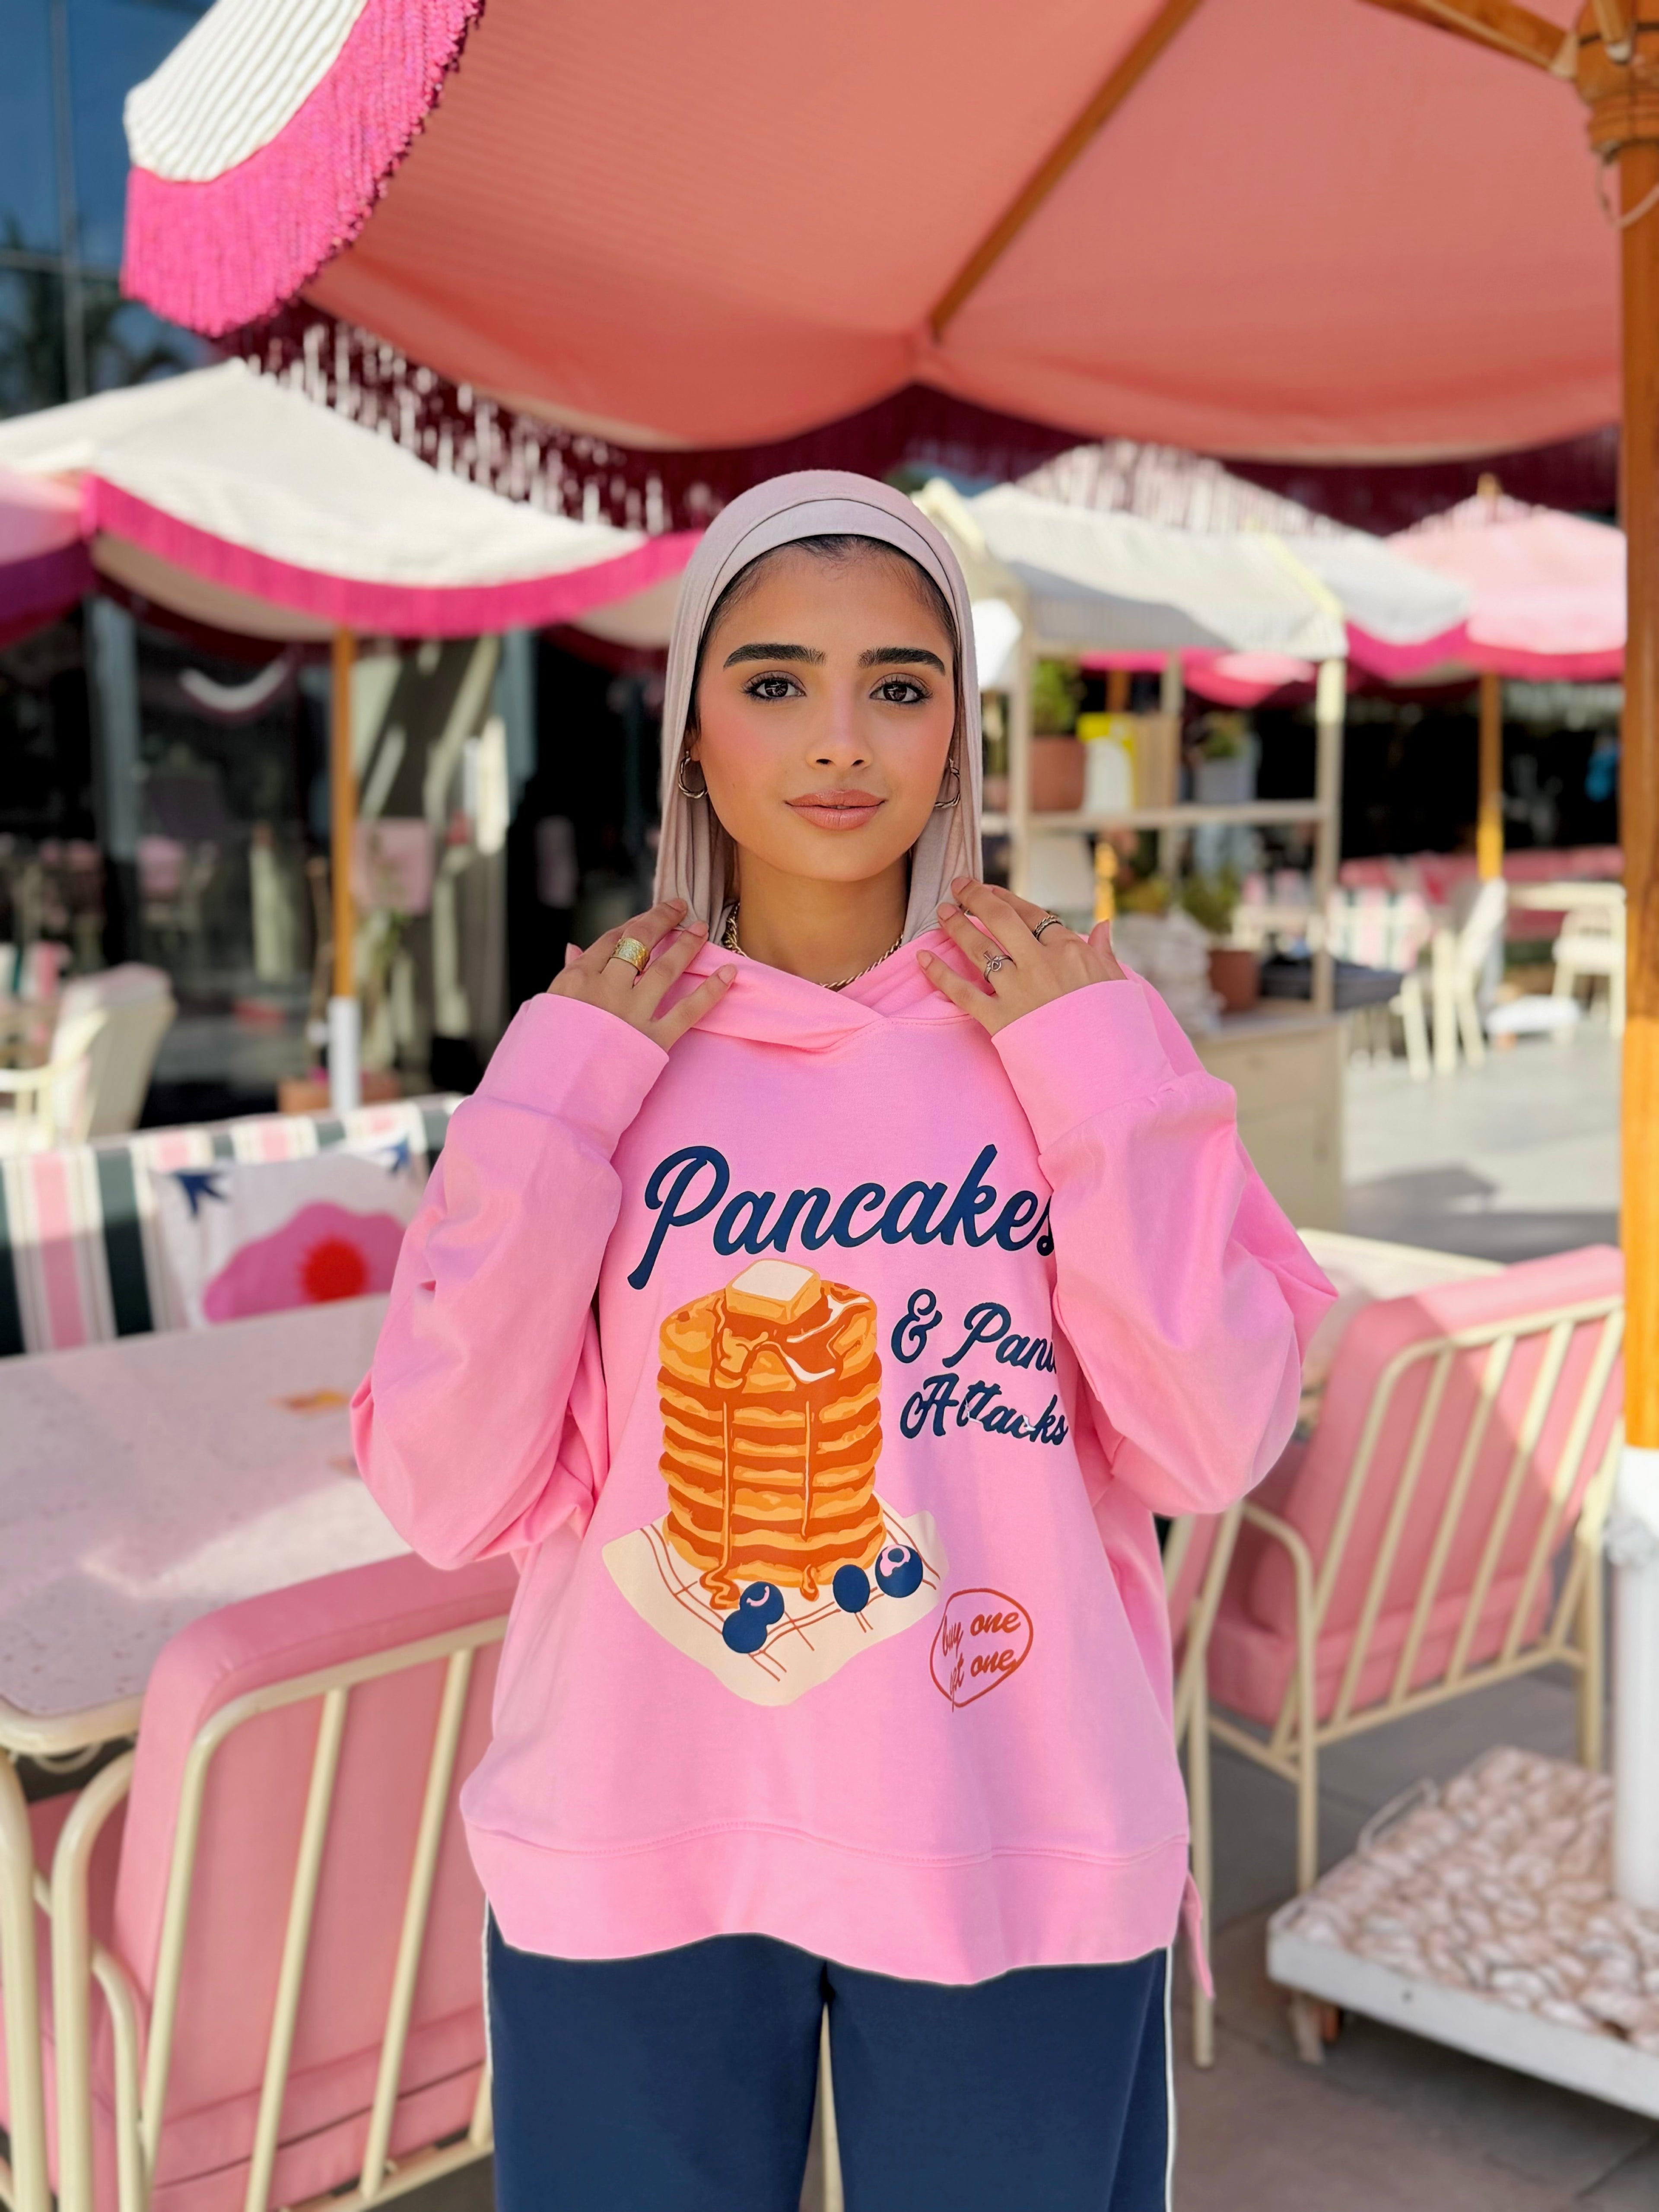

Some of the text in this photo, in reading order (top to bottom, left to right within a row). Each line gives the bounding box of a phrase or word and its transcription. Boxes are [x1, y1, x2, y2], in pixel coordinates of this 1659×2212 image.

[891, 1288, 943, 1363] &
[900, 1373, 1069, 1446] Attacks
[970, 1612, 1021, 1636] one
[970, 1649, 1017, 1677] one
